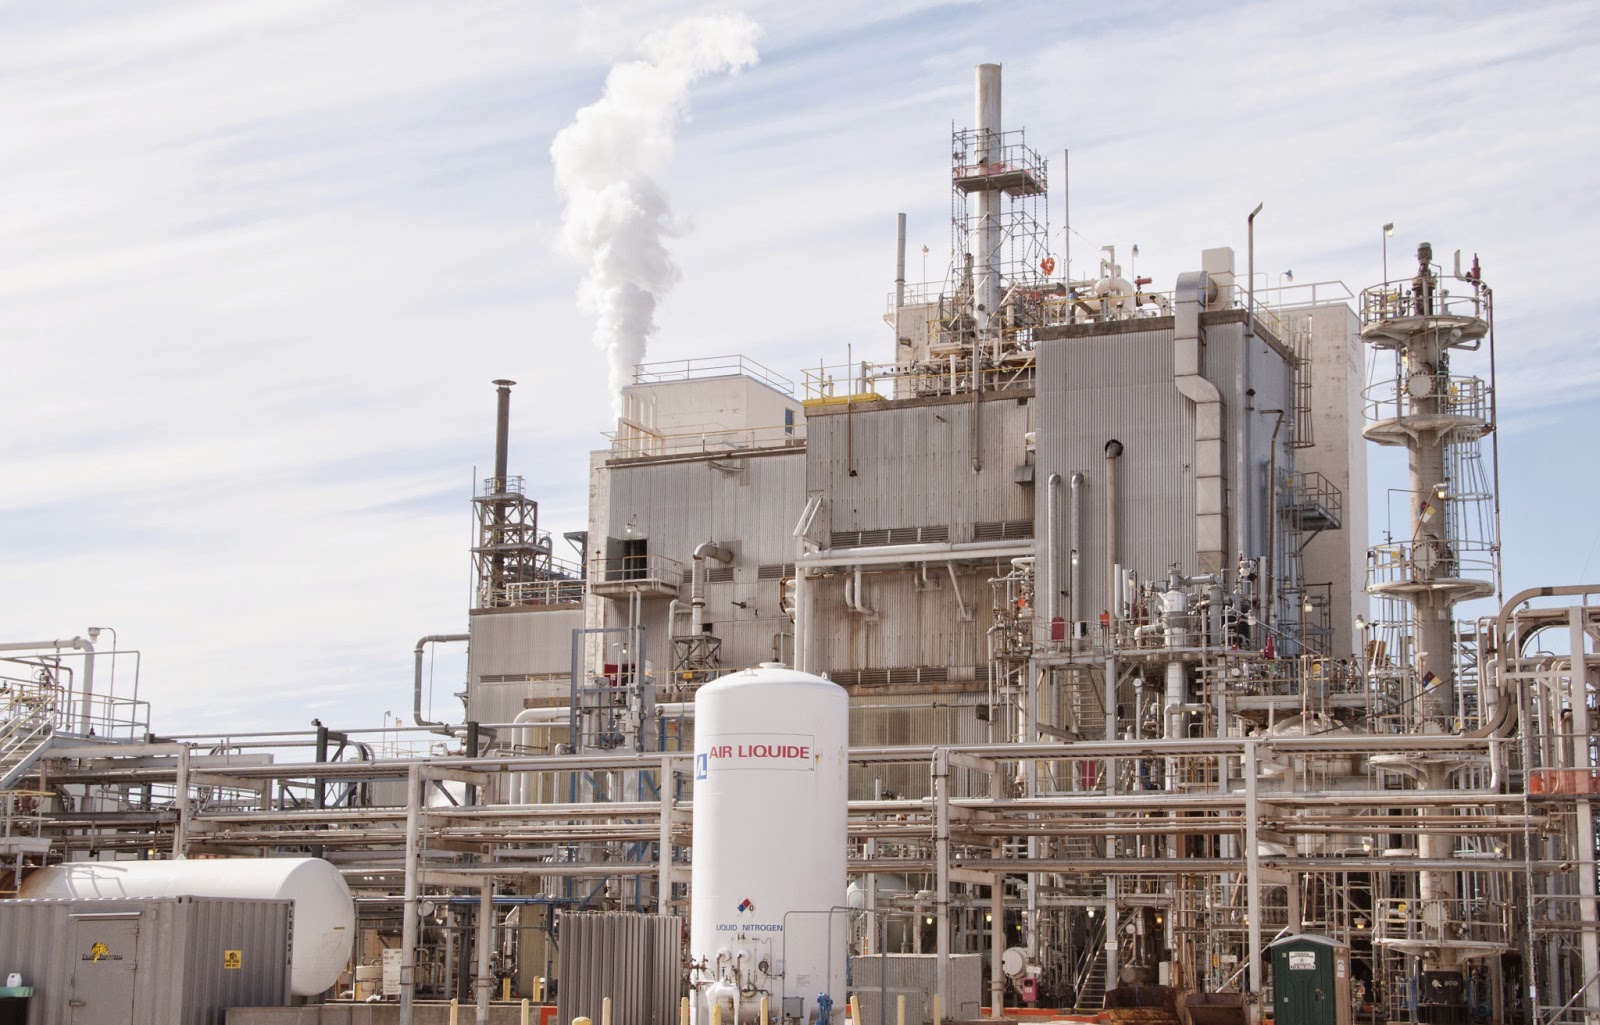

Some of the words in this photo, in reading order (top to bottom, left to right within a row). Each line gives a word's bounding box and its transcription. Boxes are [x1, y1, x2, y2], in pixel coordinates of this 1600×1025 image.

[709, 745, 733, 759] AIR
[738, 744, 810, 760] LIQUIDE
[742, 924, 783, 932] NITROGEN
